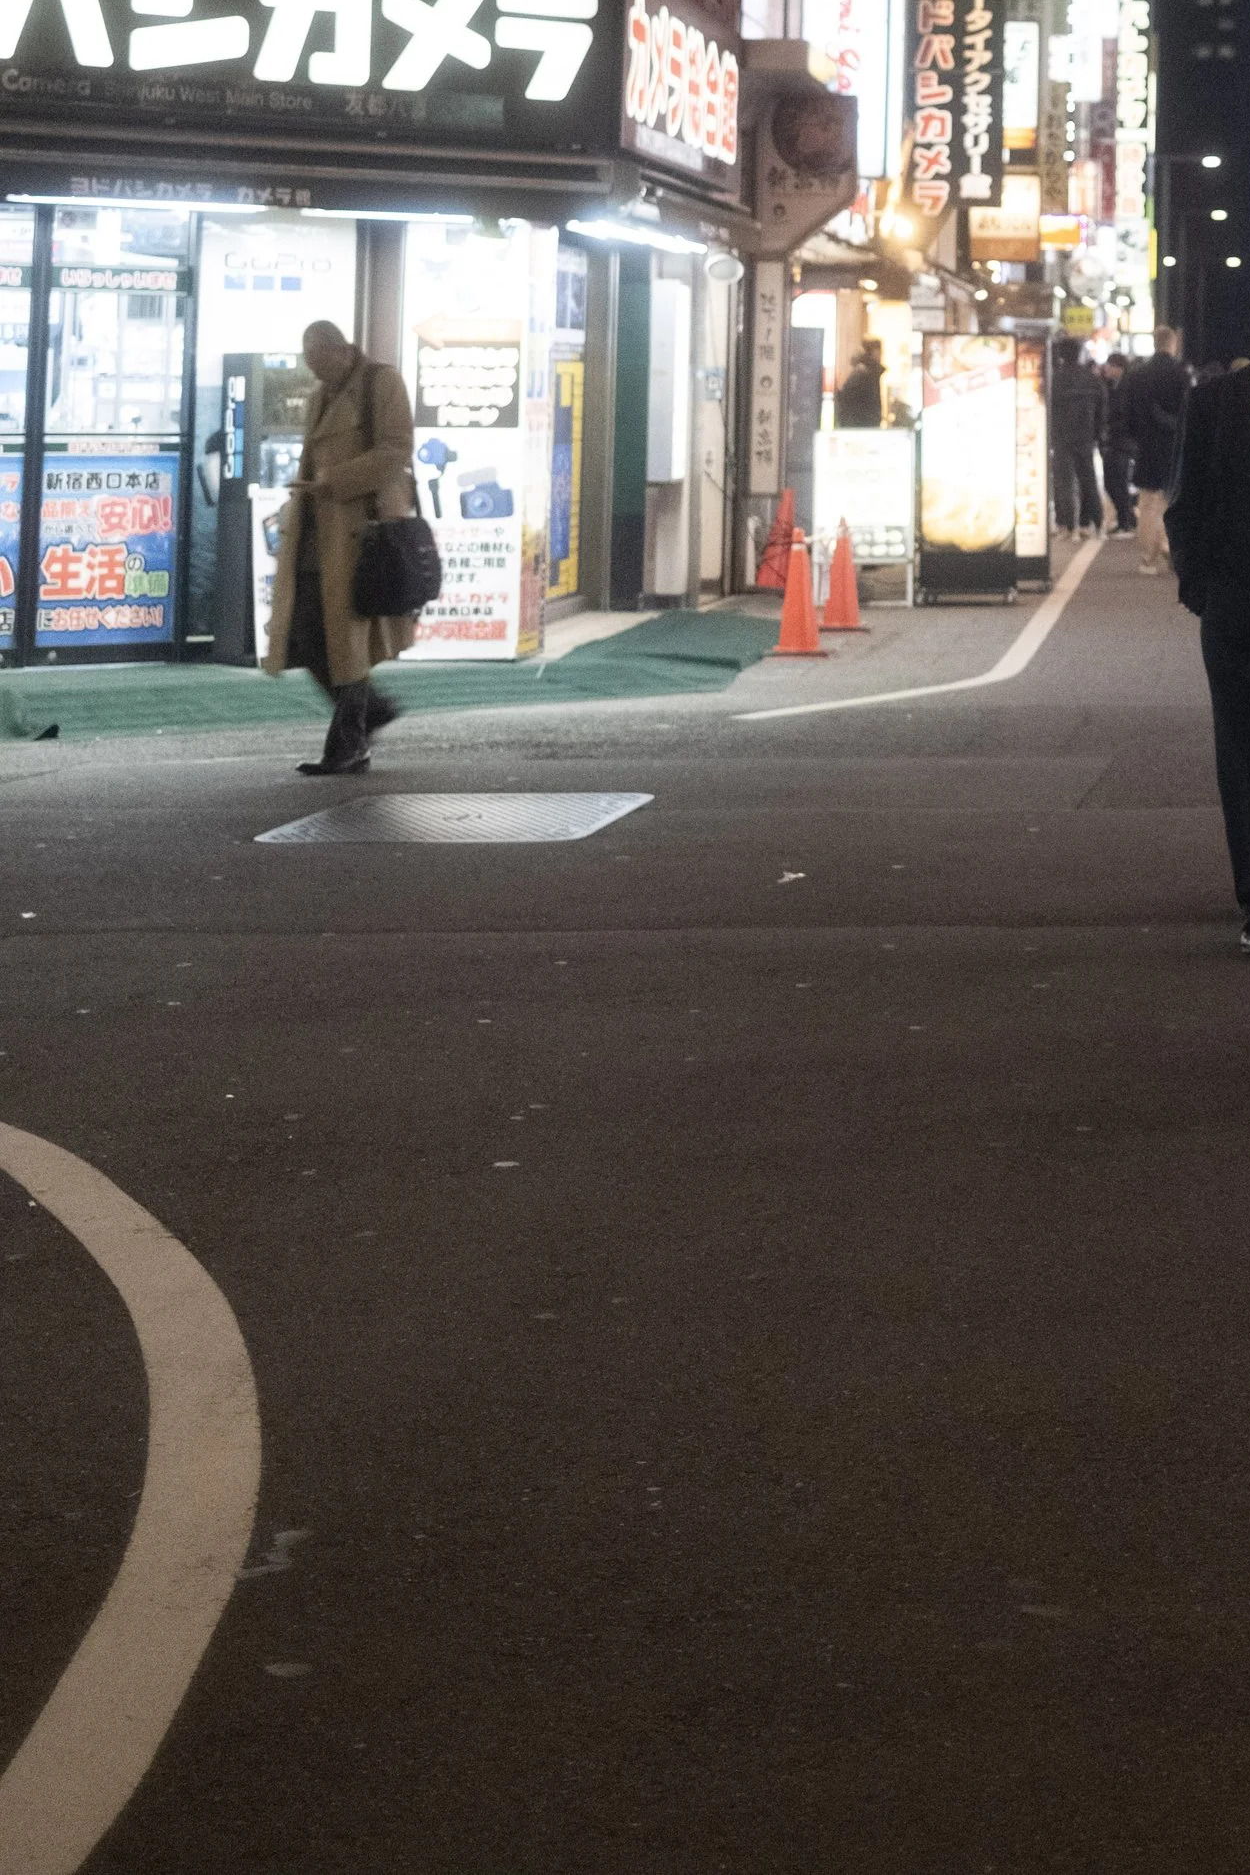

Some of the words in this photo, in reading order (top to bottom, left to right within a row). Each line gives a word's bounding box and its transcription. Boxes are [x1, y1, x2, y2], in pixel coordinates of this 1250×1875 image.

[269, 90, 313, 111] Store
[46, 471, 160, 491] 新宿西口本店
